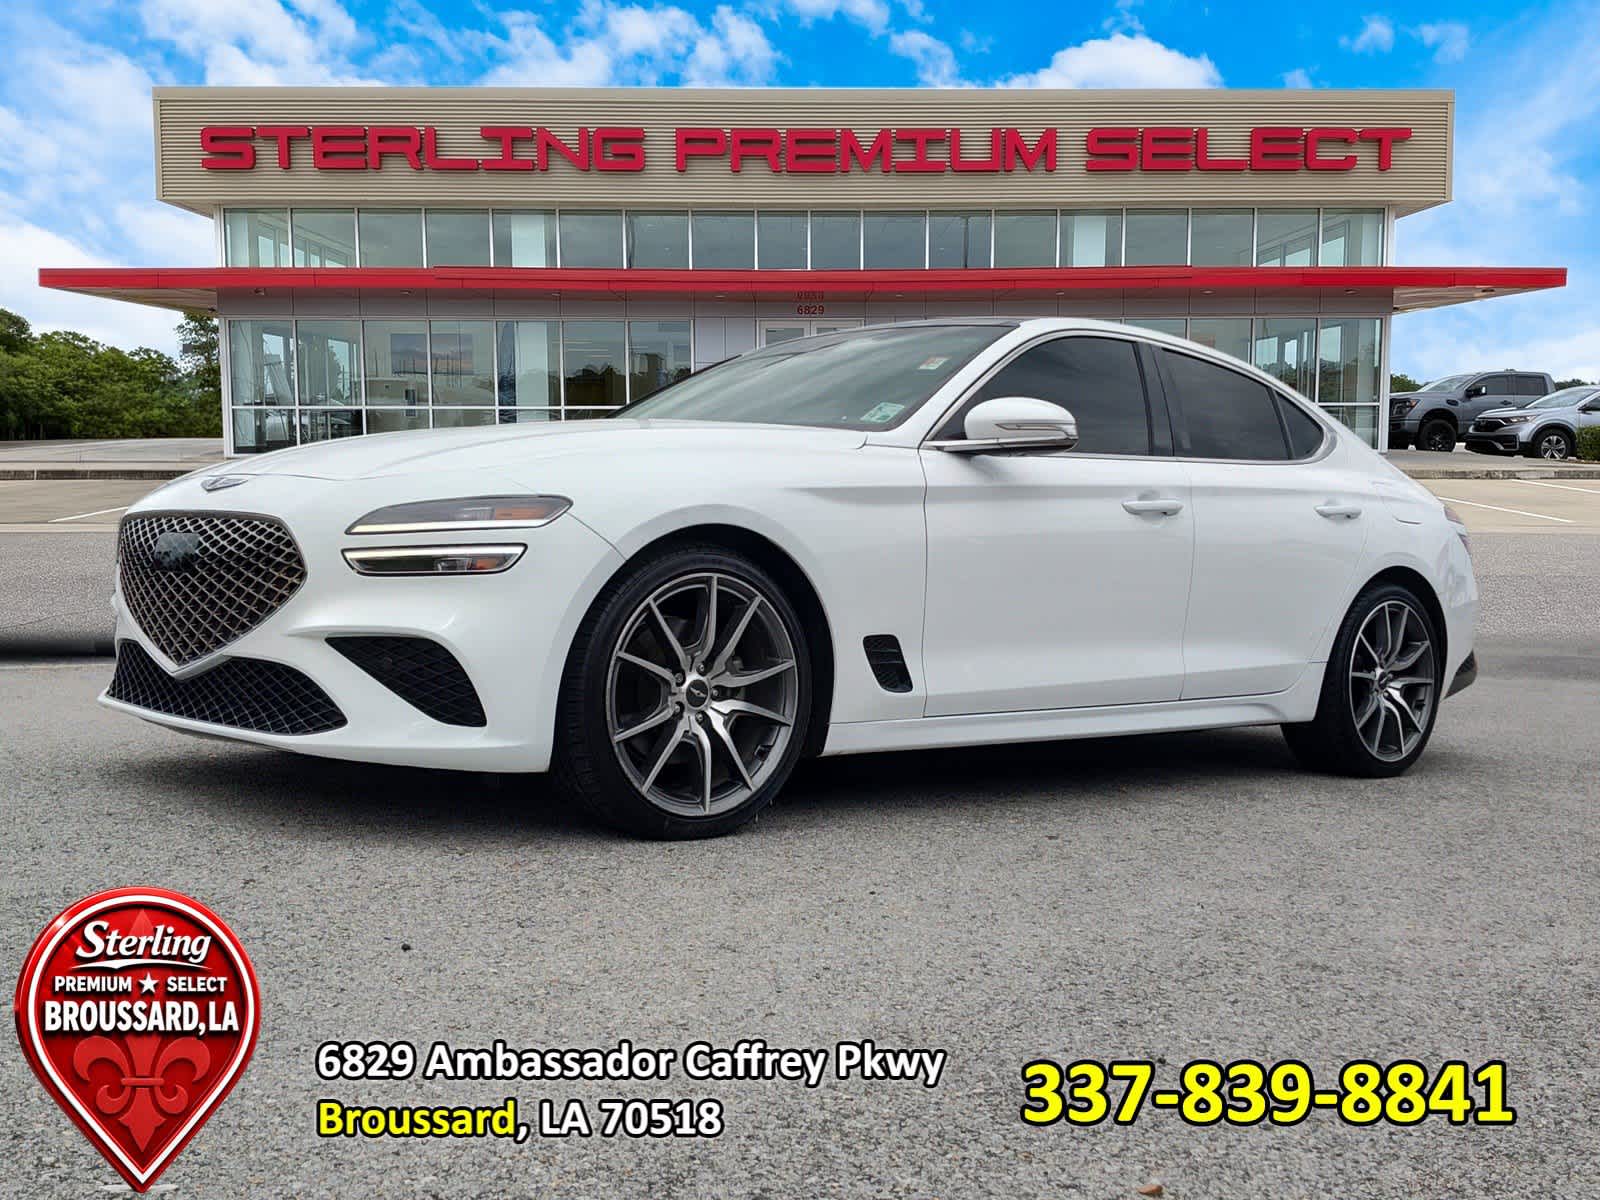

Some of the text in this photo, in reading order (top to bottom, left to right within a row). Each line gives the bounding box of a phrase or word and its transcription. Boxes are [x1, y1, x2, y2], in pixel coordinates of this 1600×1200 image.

[200, 125, 1413, 173] STERLING PREMIUM SELECT
[797, 305, 825, 315] 6829
